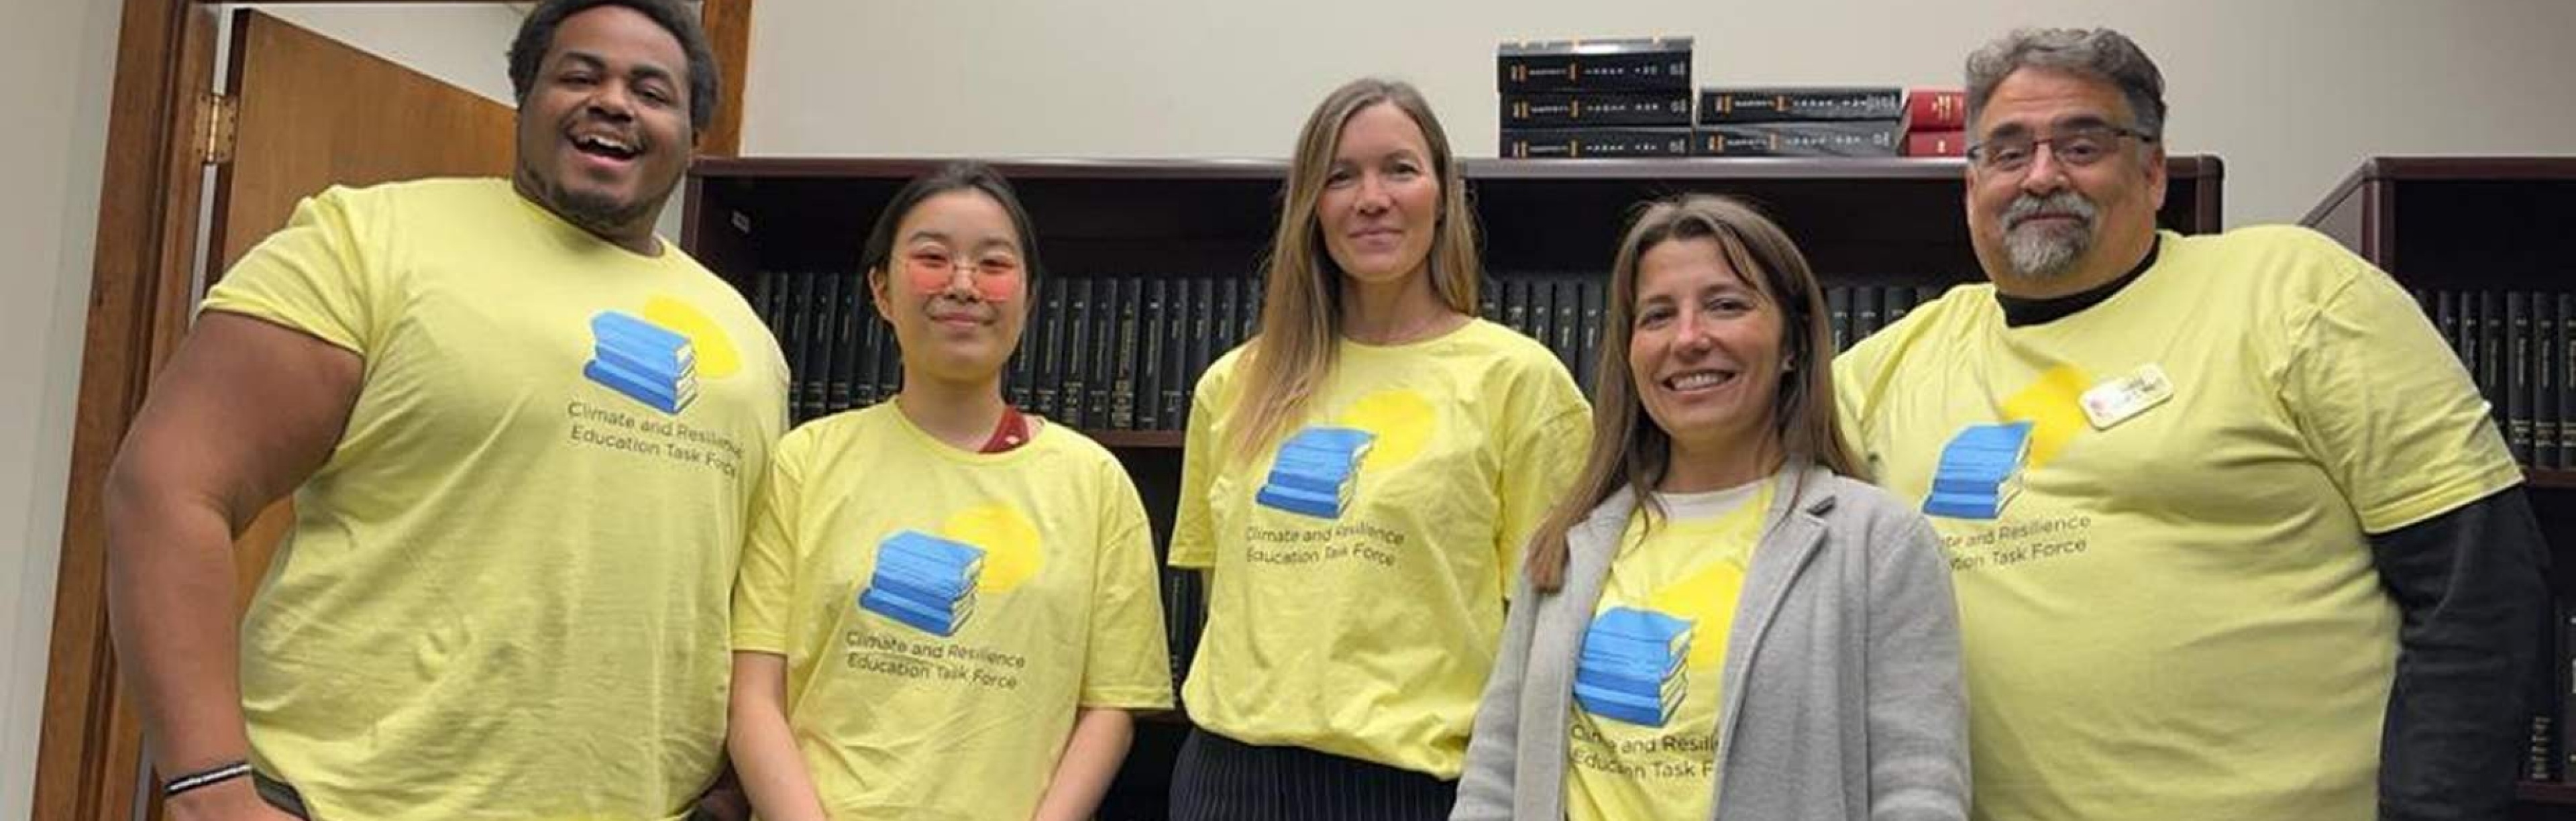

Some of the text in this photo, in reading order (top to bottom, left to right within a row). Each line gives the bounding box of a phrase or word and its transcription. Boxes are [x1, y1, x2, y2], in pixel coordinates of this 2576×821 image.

[568, 400, 635, 429] Climate
[640, 419, 672, 437] and
[570, 425, 660, 457] Education
[666, 443, 700, 463] Task
[1246, 525, 1300, 543] Climate
[1301, 527, 1332, 543] and
[1999, 515, 2092, 540] Resilience
[1352, 541, 1397, 567] Force
[1992, 545, 2028, 566] Task
[2031, 537, 2087, 561] Force
[845, 630, 1026, 669] Climate and Resilience
[847, 651, 930, 679] Education
[971, 667, 1018, 690] Force
[1621, 738, 1657, 754] and
[1653, 759, 1696, 778] Task
